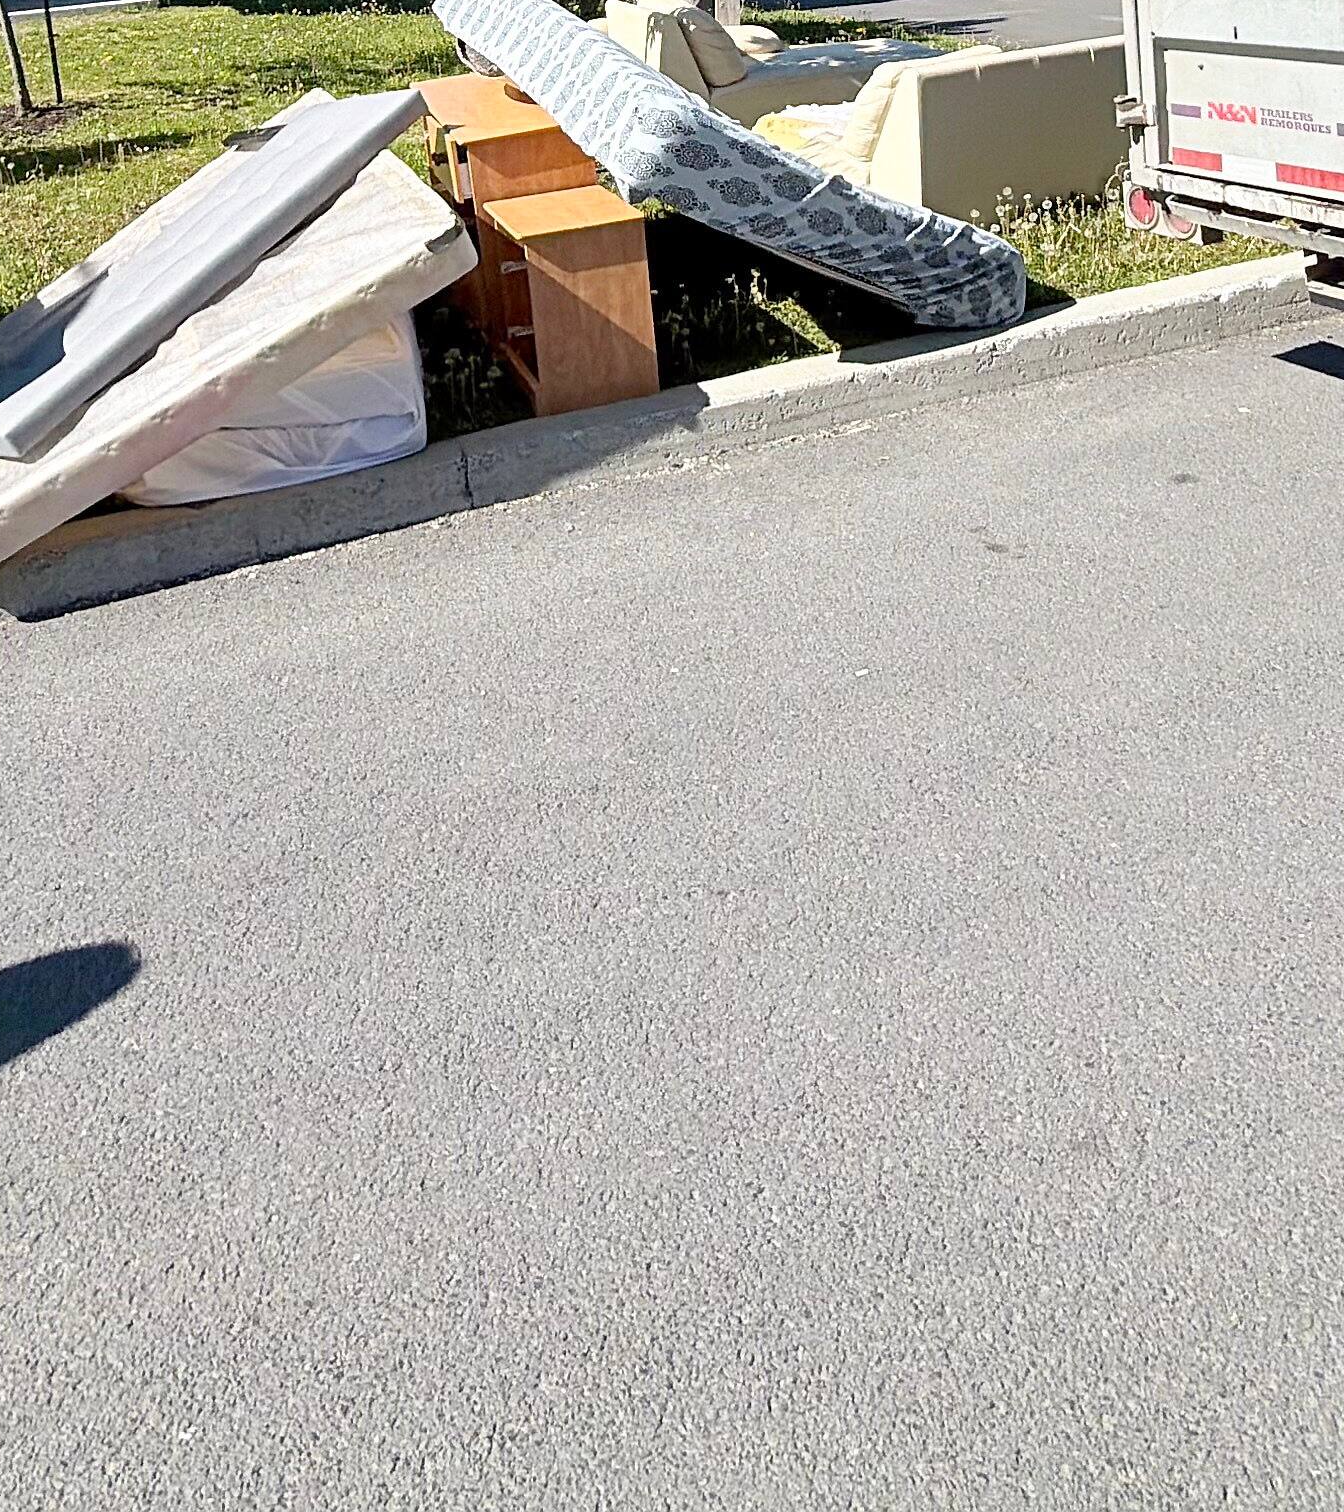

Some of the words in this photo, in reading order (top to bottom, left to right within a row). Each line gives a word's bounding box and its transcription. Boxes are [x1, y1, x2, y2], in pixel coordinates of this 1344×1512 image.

[1207, 101, 1257, 125] N&N
[1260, 107, 1314, 122] TRAILERS
[1260, 117, 1332, 134] REMORQUES
